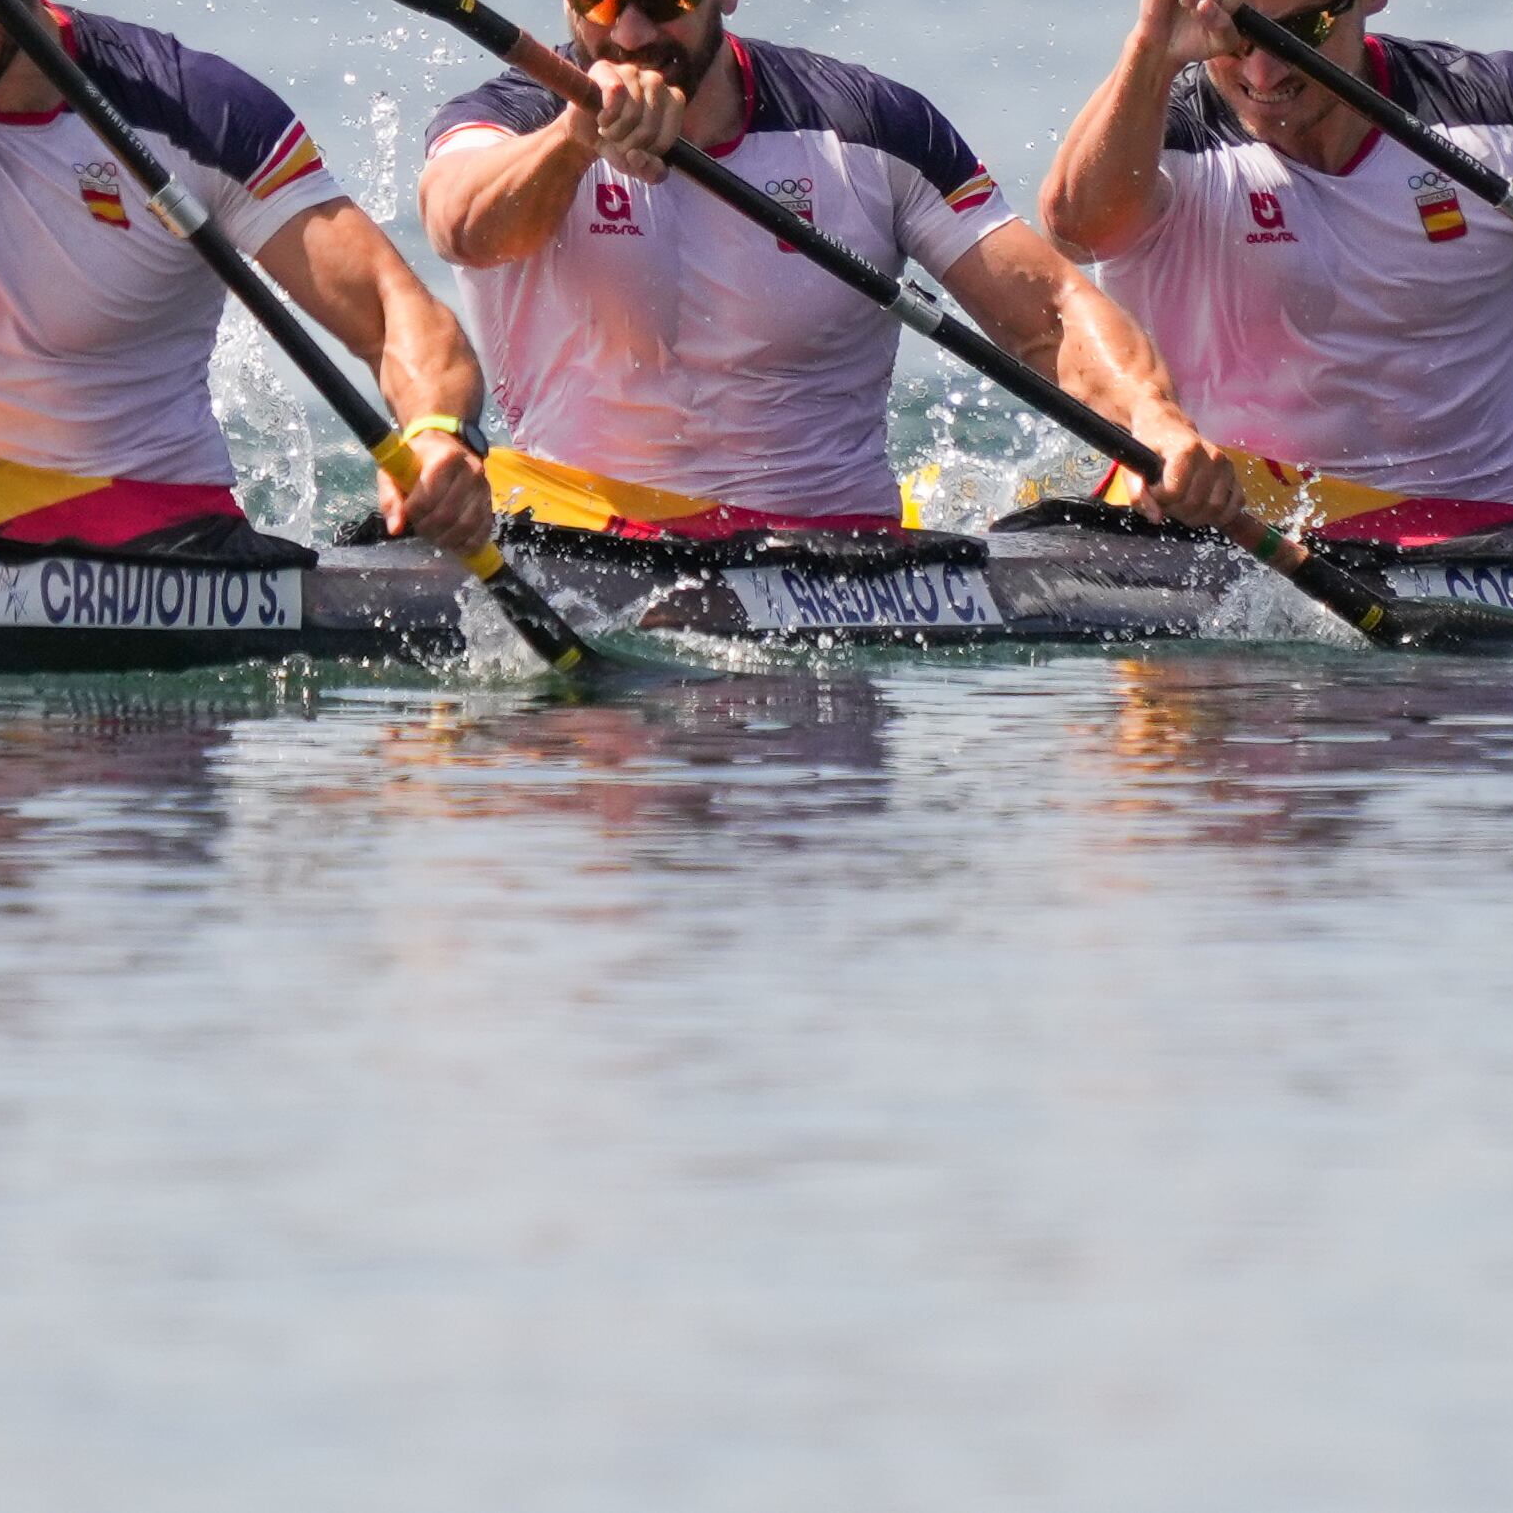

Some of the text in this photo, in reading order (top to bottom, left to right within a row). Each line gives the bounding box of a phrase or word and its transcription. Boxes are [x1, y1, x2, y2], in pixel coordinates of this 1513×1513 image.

[40, 560, 285, 627] CRAVIOTTO S.
[781, 563, 986, 624] AREVALO C.
